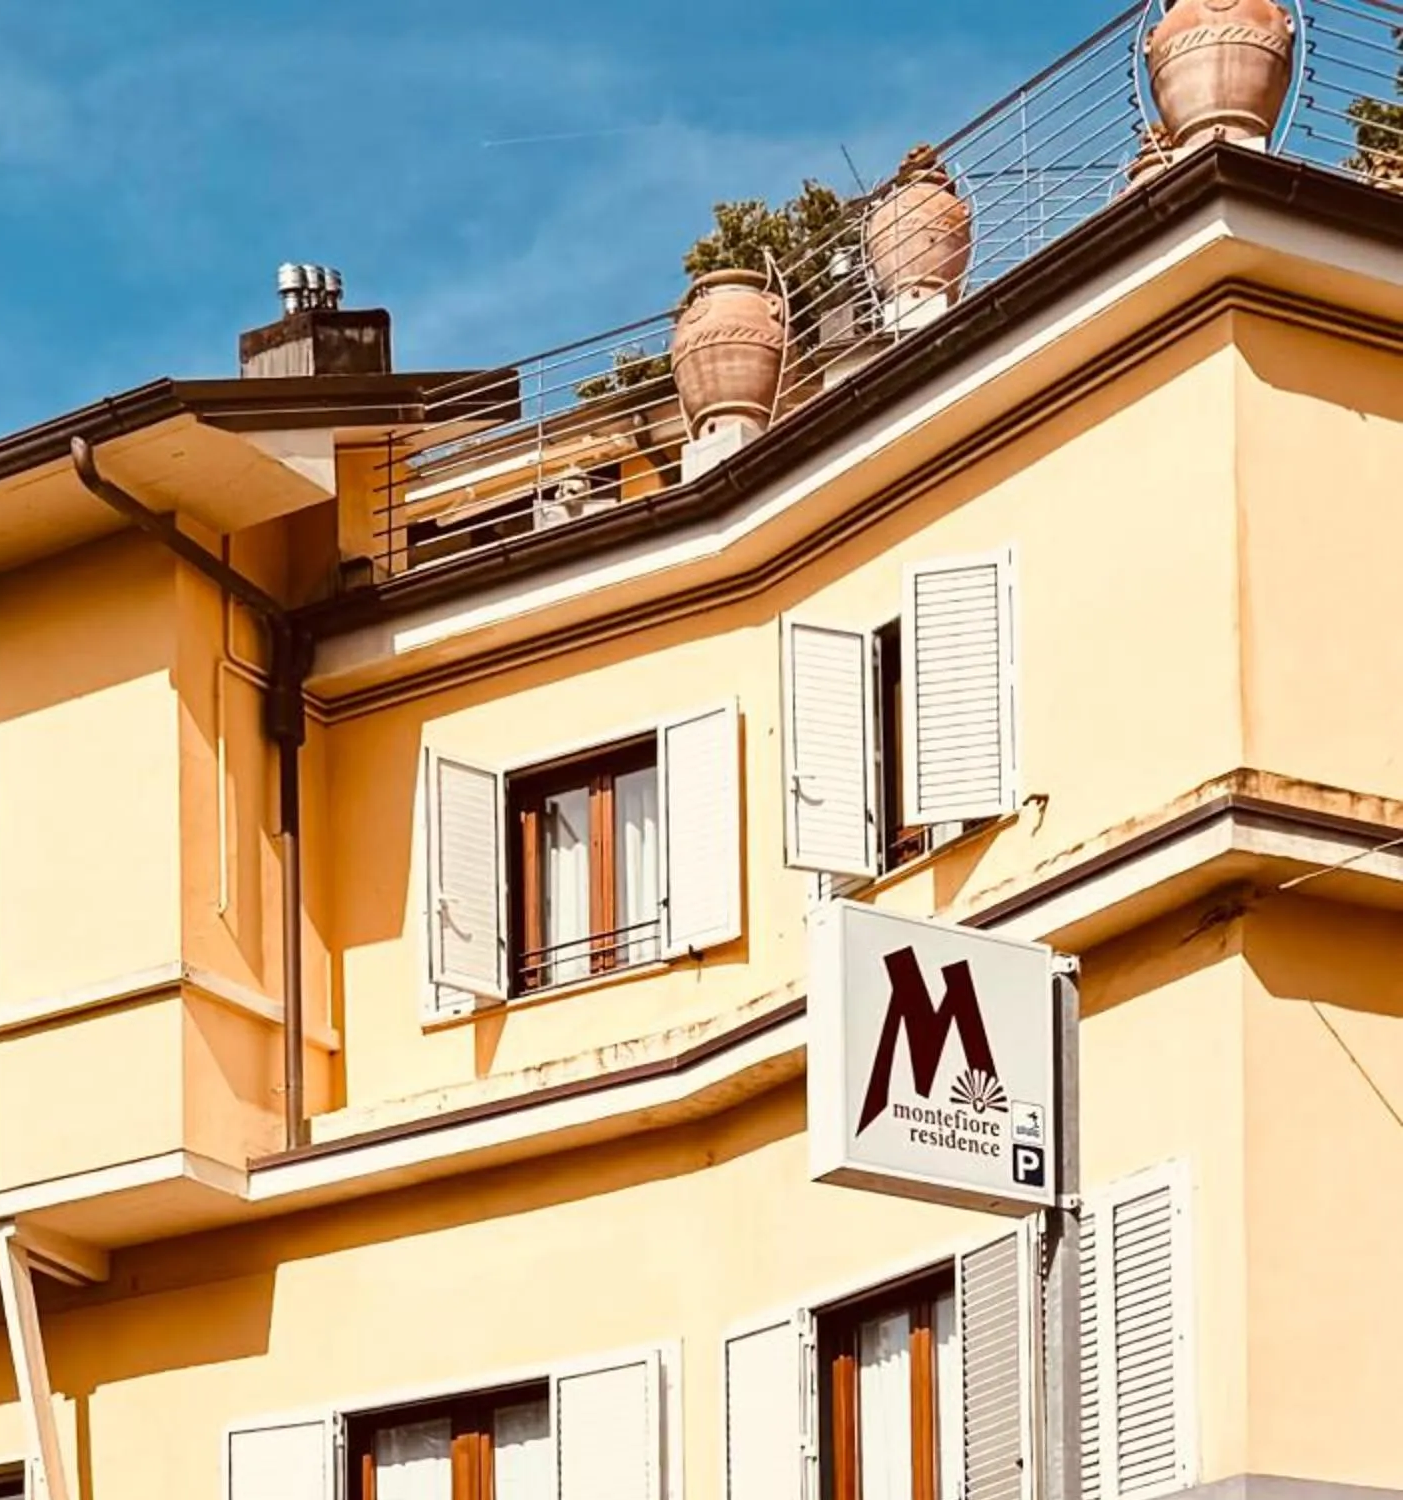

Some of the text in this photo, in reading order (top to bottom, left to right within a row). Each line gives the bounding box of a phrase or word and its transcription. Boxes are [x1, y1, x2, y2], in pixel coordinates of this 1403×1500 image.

[855, 945, 999, 1138] M
[893, 1103, 1000, 1137] montefiore
[910, 1127, 1000, 1157] residence
[1017, 1149, 1040, 1181] P
